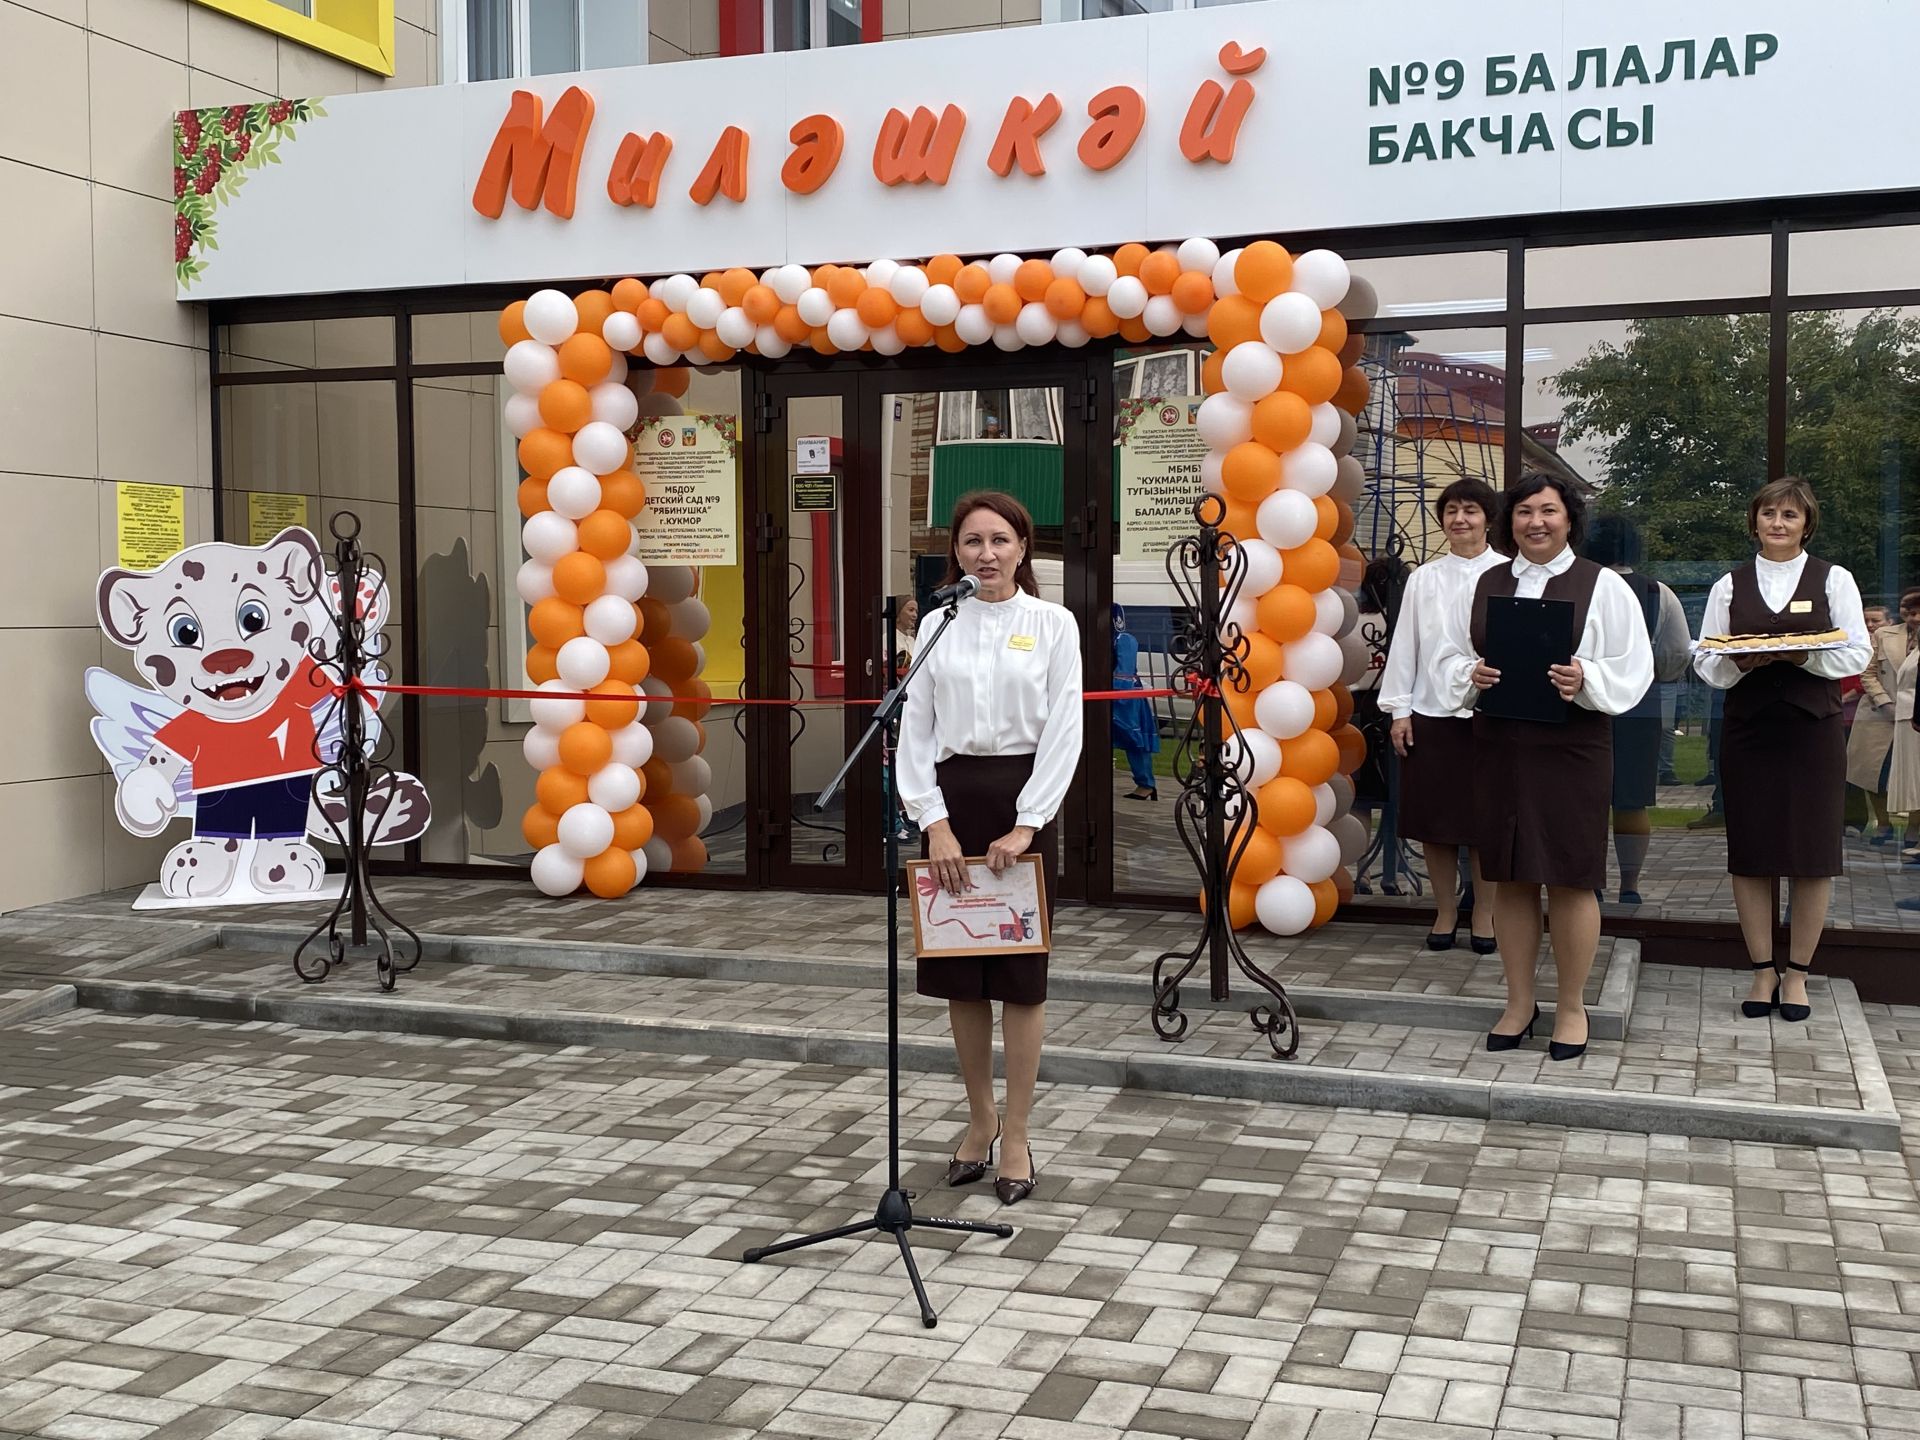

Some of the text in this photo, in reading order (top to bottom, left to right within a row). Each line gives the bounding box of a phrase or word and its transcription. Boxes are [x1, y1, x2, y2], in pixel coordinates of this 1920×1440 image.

[1368, 59, 1465, 106] №9
[473, 40, 1267, 220] Миләшкәй
[664, 486, 696, 494] МБДОУ
[1127, 486, 1192, 496] ТУГЫЗЫНЧЫ
[644, 494, 721, 505] ДЕТСКИЙ САД №9
[1135, 507, 1182, 517] БАЛАЛАР
